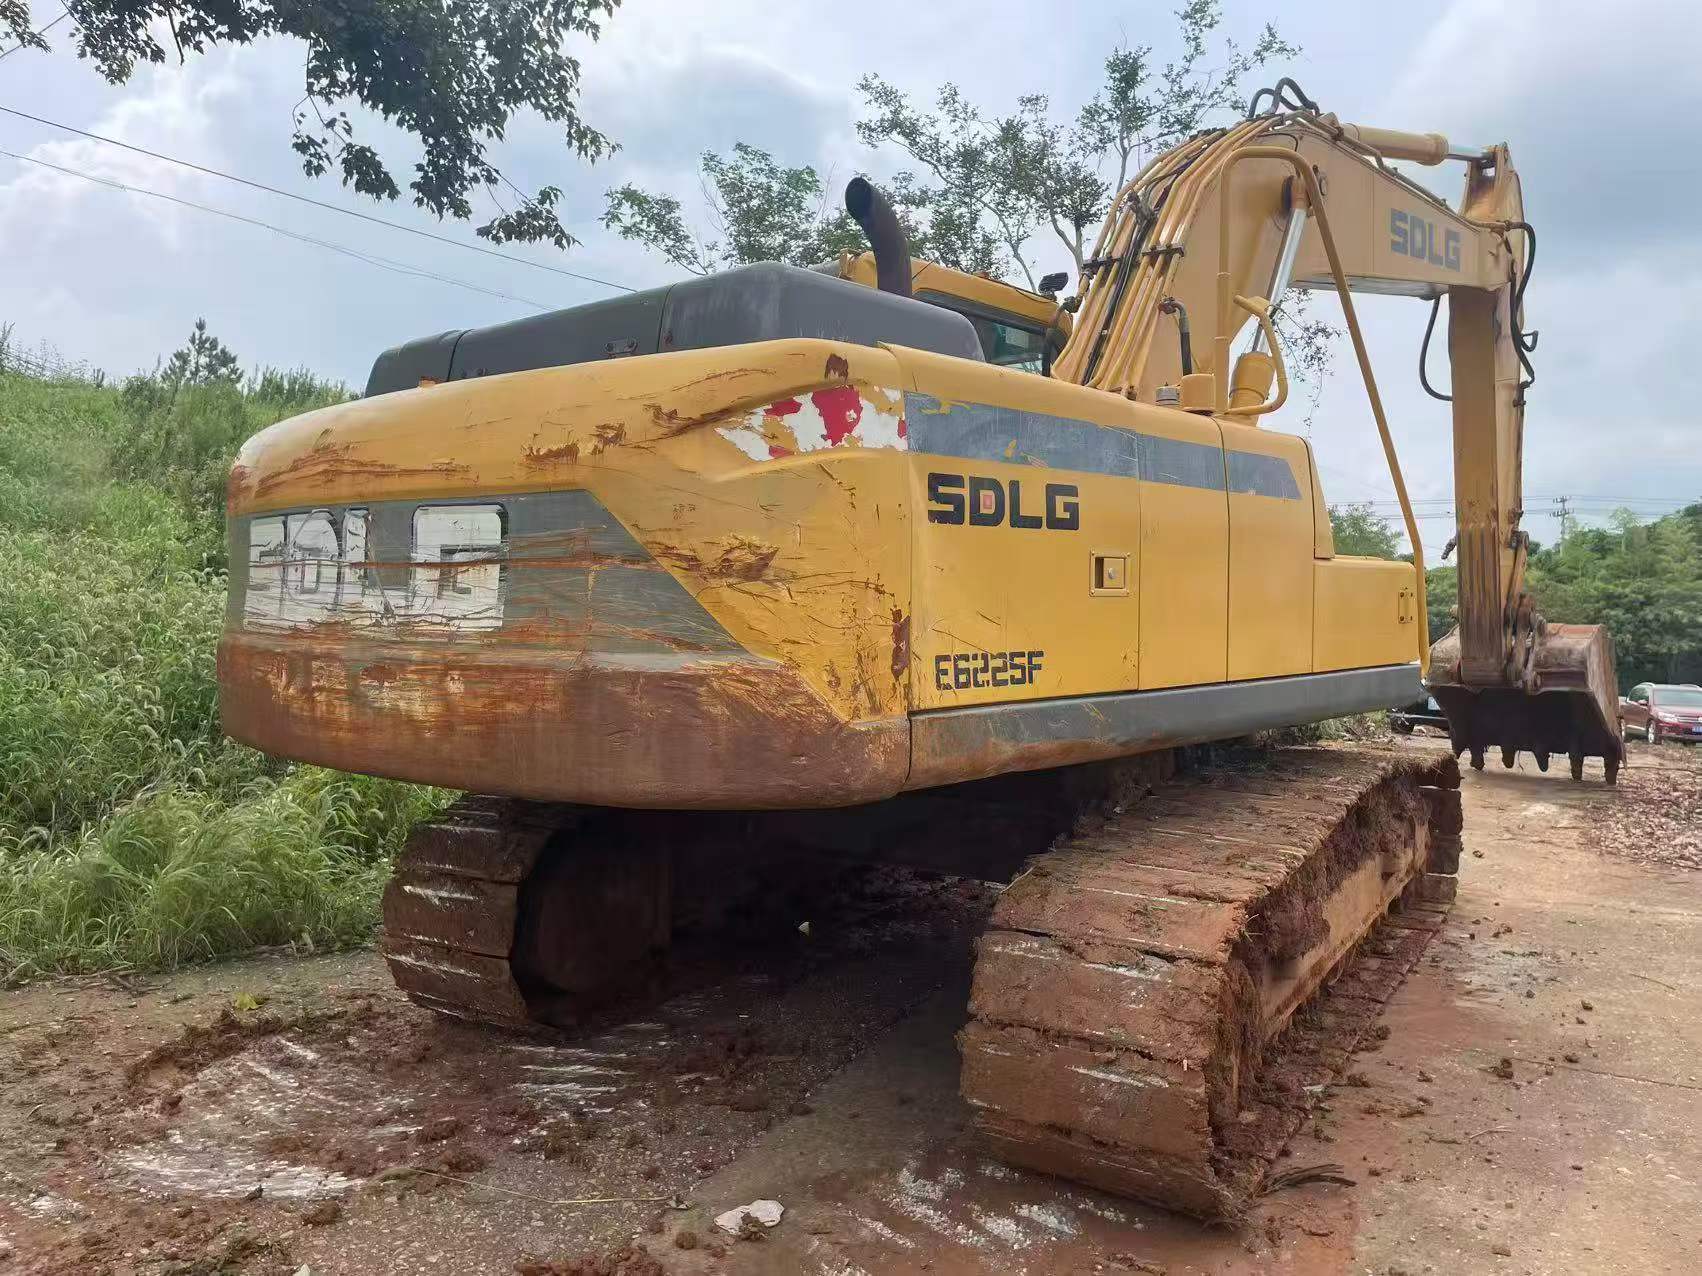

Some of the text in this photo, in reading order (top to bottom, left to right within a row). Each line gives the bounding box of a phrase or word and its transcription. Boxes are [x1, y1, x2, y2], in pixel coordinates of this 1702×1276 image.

[1390, 207, 1461, 272] SDLG
[927, 472, 1080, 530] SDLG
[934, 650, 1044, 691] E6225F
